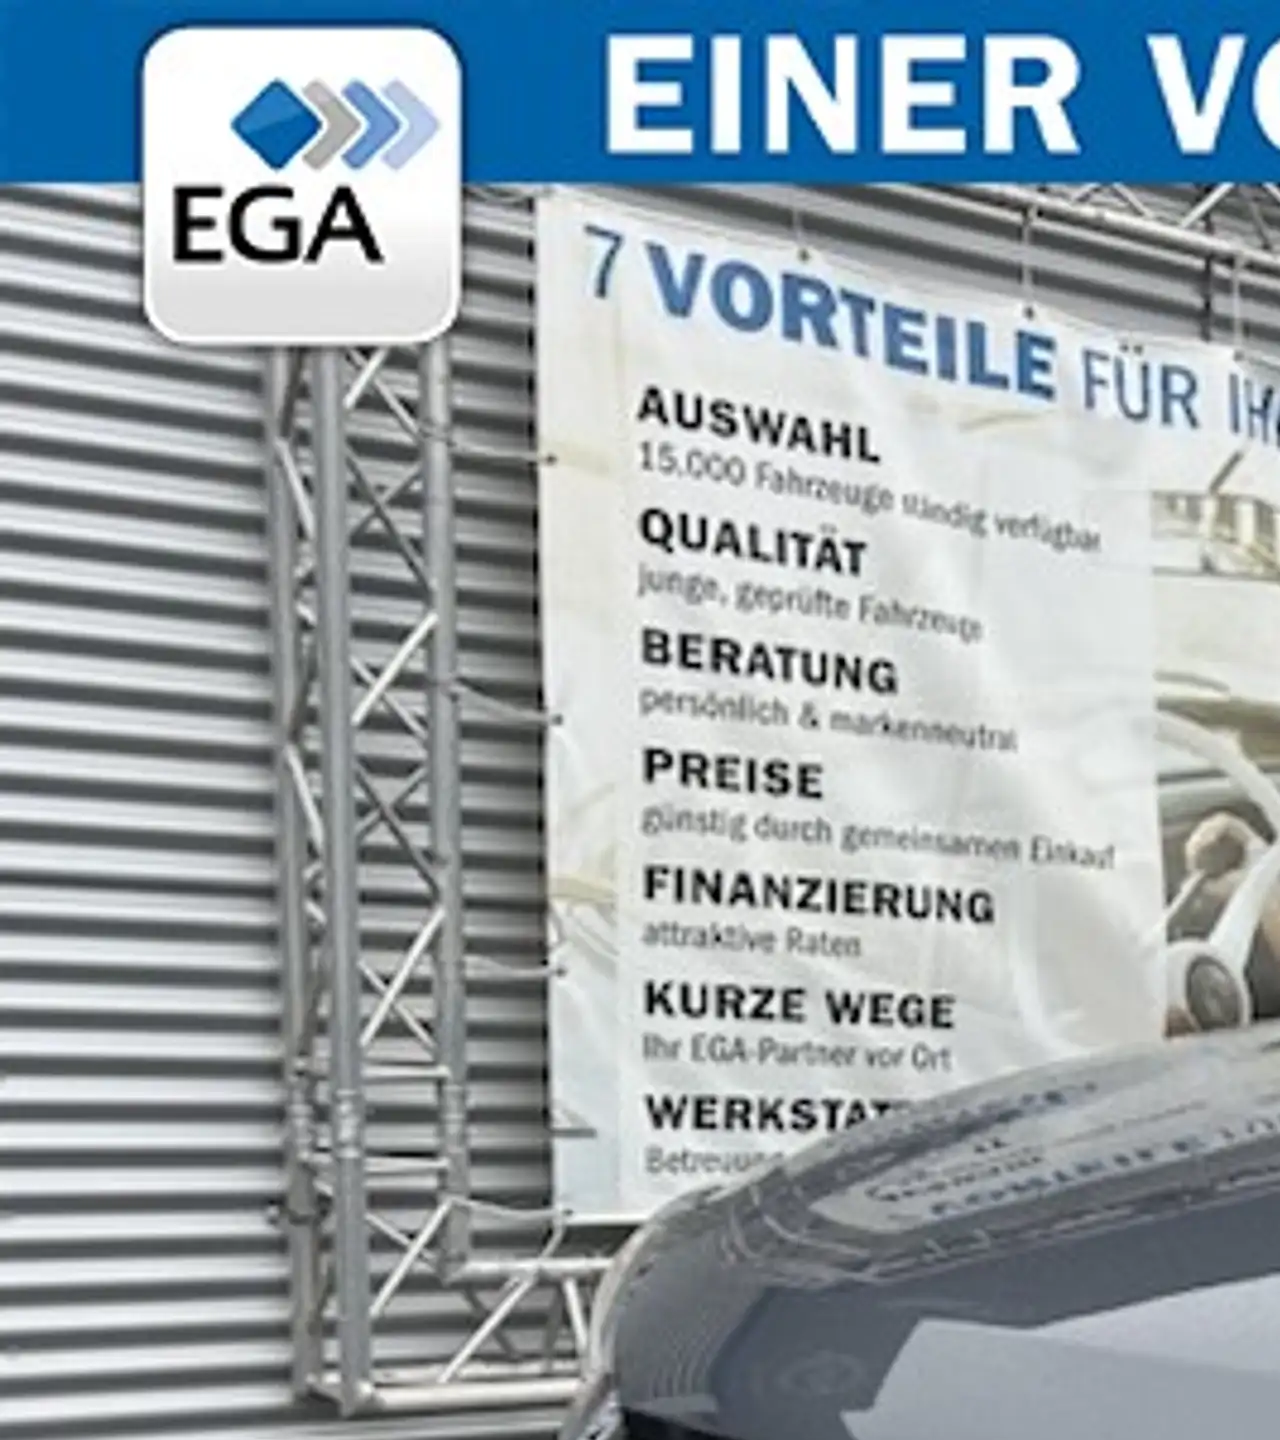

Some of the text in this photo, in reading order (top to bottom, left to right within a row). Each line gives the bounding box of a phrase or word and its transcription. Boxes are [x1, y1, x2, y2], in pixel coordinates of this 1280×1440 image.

[583, 225, 625, 299] 7
[643, 241, 1058, 402] VORTEILE
[1082, 344, 1199, 428] FÜR
[637, 385, 881, 463] AUSWAHL
[638, 440, 1101, 553] 15.000 Fahrzeuge ständig verfügbar
[638, 507, 868, 577] QUALITÄT
[637, 562, 983, 644] junge, geprüfte Fahrzeuge
[641, 628, 898, 695] BERATUNG
[639, 687, 1017, 753] persönlich & markenneutral
[643, 747, 824, 799] PREISE
[641, 805, 1116, 869] günstig durch gemeinsamen Einkauf
[643, 865, 996, 924] FINANZIERUNG
[642, 920, 862, 957] attraktive Raten
[644, 979, 956, 1029] KURZE WEGE
[642, 1034, 952, 1072] Ihr EGA-Partner vor Ort
